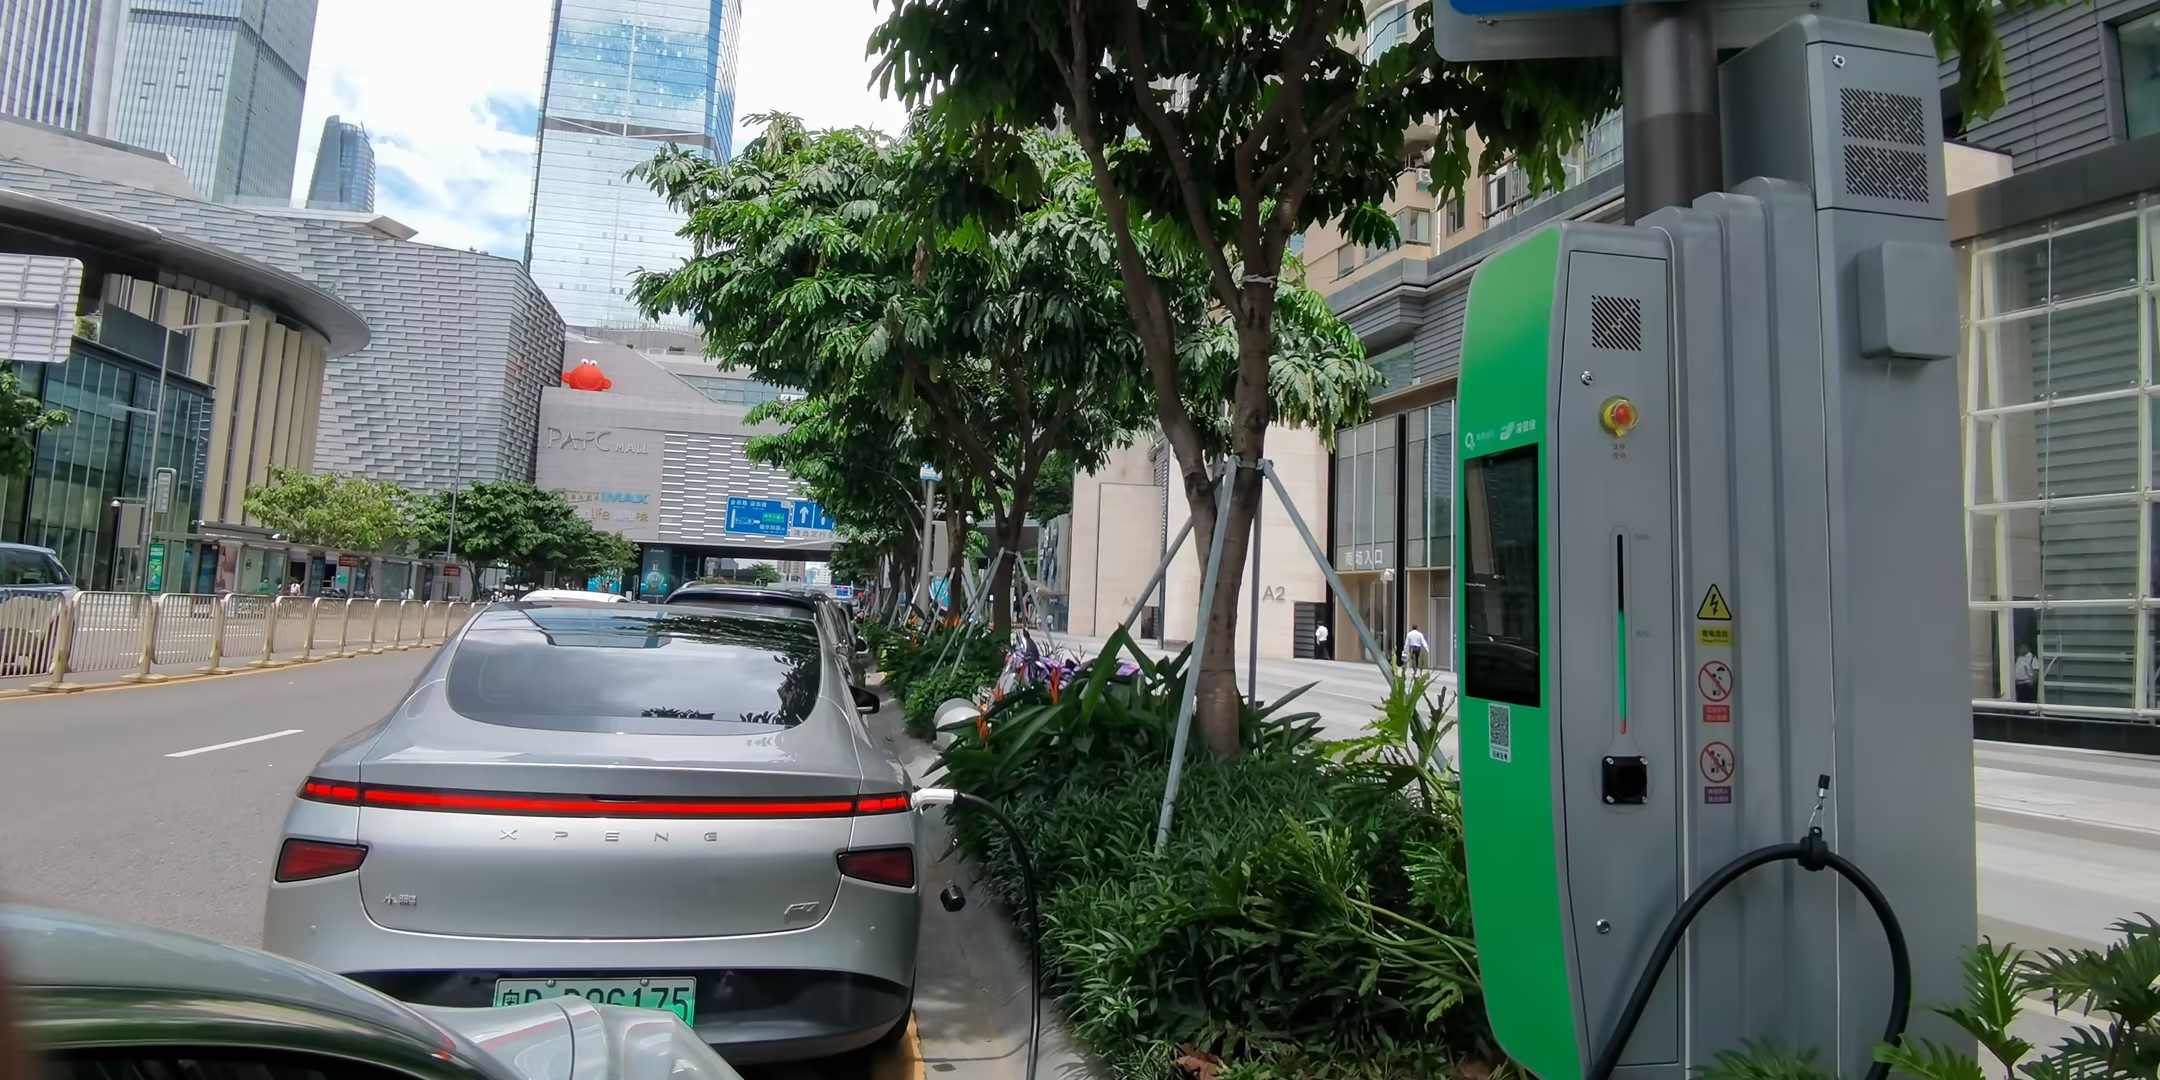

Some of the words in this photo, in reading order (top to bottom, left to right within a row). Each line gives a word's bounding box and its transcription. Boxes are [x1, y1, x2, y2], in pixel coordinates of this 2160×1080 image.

[547, 426, 612, 452] PAFC
[615, 440, 649, 455] MALL
[1263, 585, 1286, 601] A2
[499, 829, 718, 842] XPENG
[383, 893, 417, 906] 小鹏
